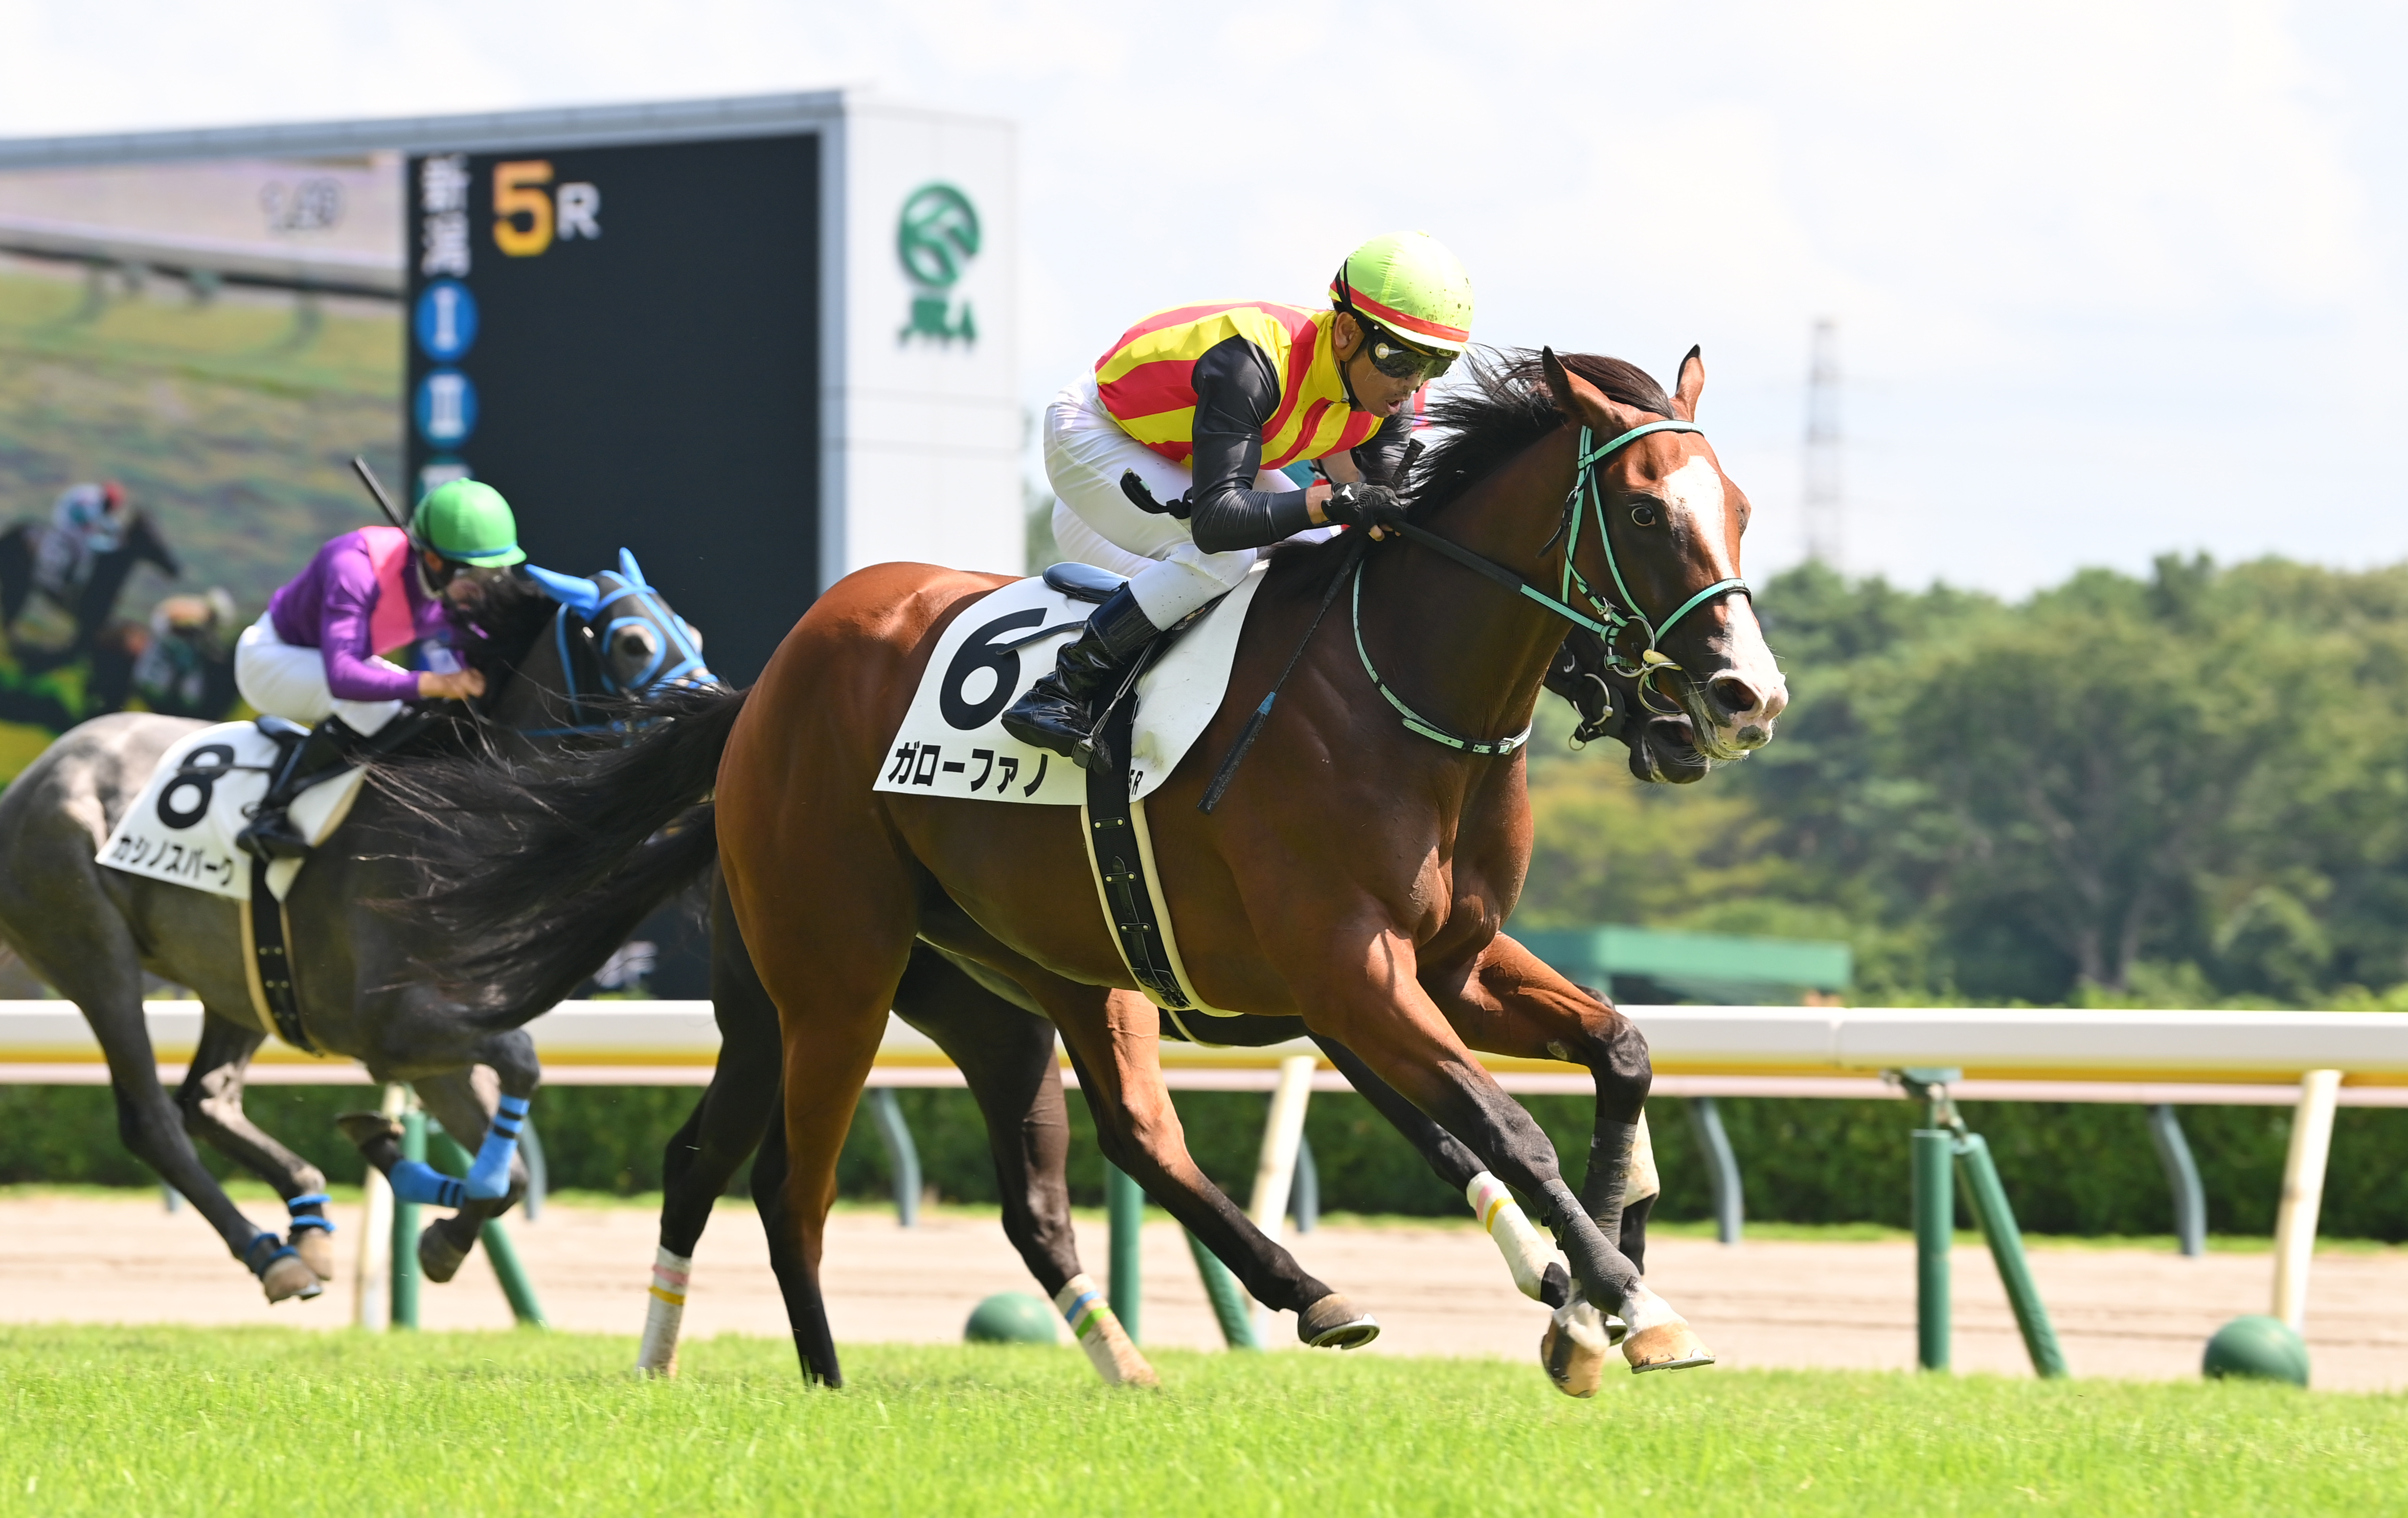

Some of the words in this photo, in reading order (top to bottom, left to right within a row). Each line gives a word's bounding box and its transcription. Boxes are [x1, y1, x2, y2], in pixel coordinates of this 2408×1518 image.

[939, 607, 1048, 731] 6
[157, 743, 235, 829] 8
[888, 740, 1048, 798] ガローファノ
[110, 834, 235, 886] カシノスパーク
